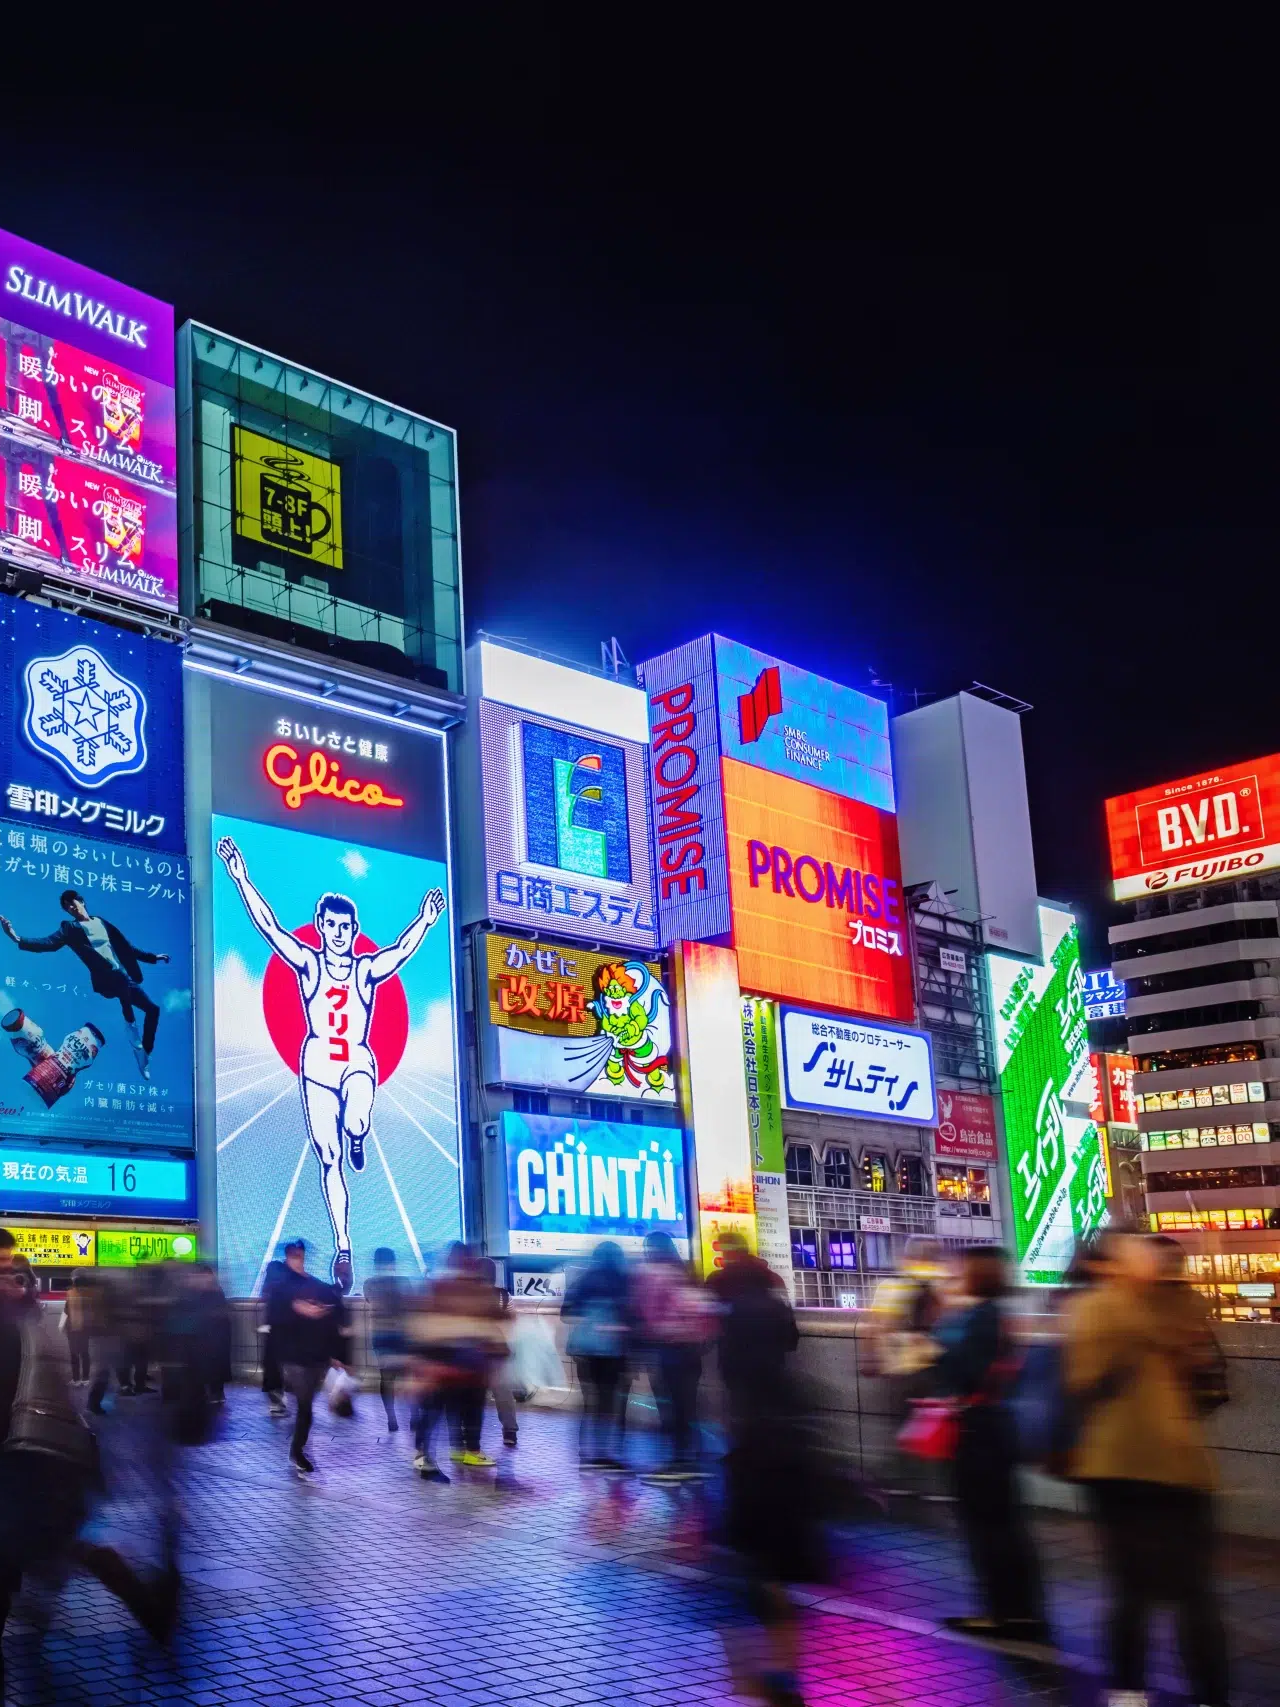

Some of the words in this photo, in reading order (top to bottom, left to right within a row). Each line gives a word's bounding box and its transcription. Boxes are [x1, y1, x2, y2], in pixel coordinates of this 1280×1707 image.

[5, 265, 149, 349] SLIMWALK
[83, 365, 99, 377] NEW
[84, 480, 100, 492] NEW
[276, 718, 389, 762] おいしさと健康
[784, 725, 808, 742] SMBC
[785, 737, 831, 762] CONSUMER
[265, 744, 404, 809] Glico
[786, 749, 824, 771] FINANCE
[5, 782, 167, 837] 雪印メグミルク
[650, 682, 708, 899] PROMISE
[1164, 783, 1193, 796] Since
[1157, 791, 1250, 852] B.V.D.
[747, 838, 900, 924] PROMISE
[1173, 852, 1265, 883] FUJIBO
[496, 871, 658, 931] 日商エステム
[505, 943, 578, 978] かぜに
[848, 920, 903, 957] プロミス
[497, 973, 587, 1024] 改源
[1055, 957, 1085, 1041] エイブル
[325, 984, 350, 1062] グリコ
[811, 1022, 912, 1051] 総合不動産のプロデューサー
[742, 1001, 765, 1168] 株式会社日本リート
[1016, 1076, 1068, 1222] エイブル
[2, 1162, 89, 1184] 現在の気温
[107, 1162, 137, 1193] 16
